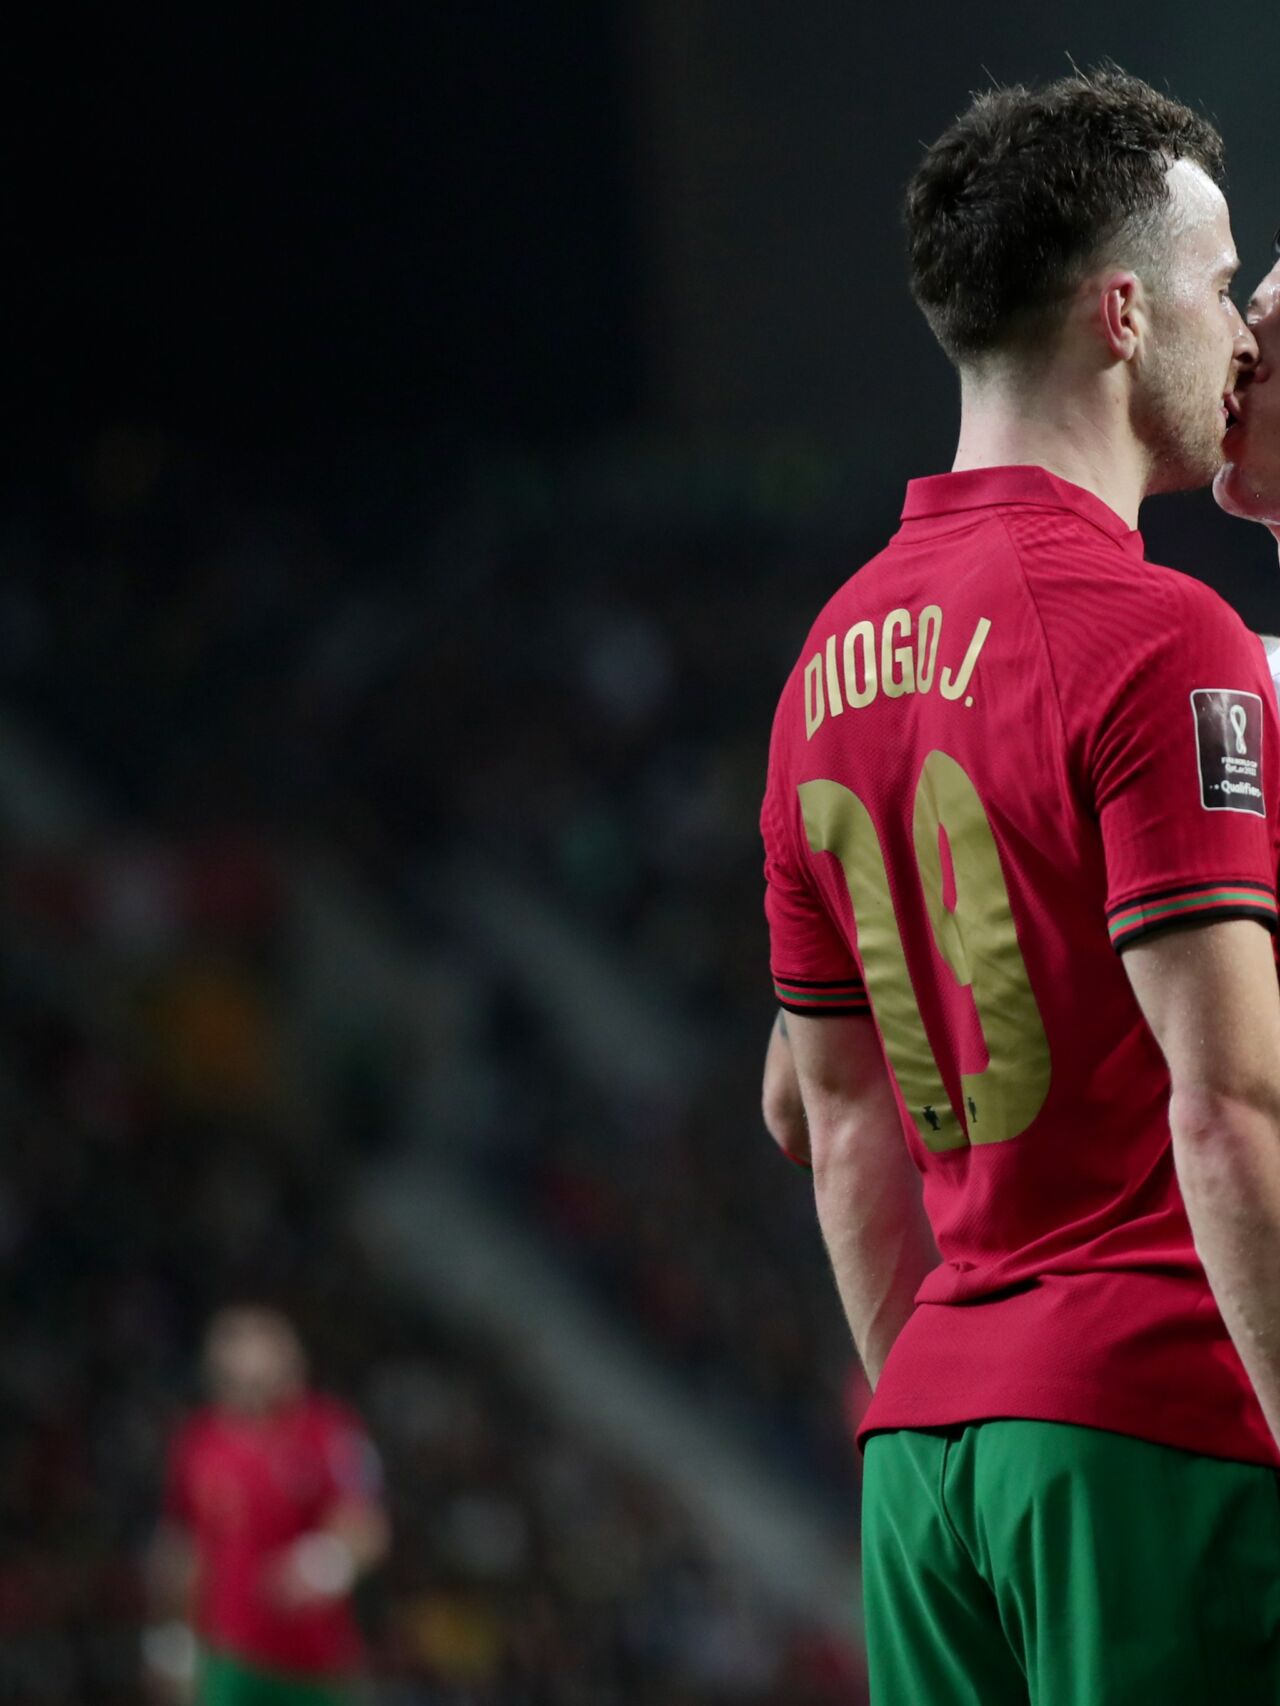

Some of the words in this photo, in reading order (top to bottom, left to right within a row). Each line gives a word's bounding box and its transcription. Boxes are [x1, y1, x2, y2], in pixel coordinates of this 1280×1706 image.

[804, 604, 943, 742] DIOGO
[939, 616, 992, 708] J.
[797, 749, 1052, 1153] 19
